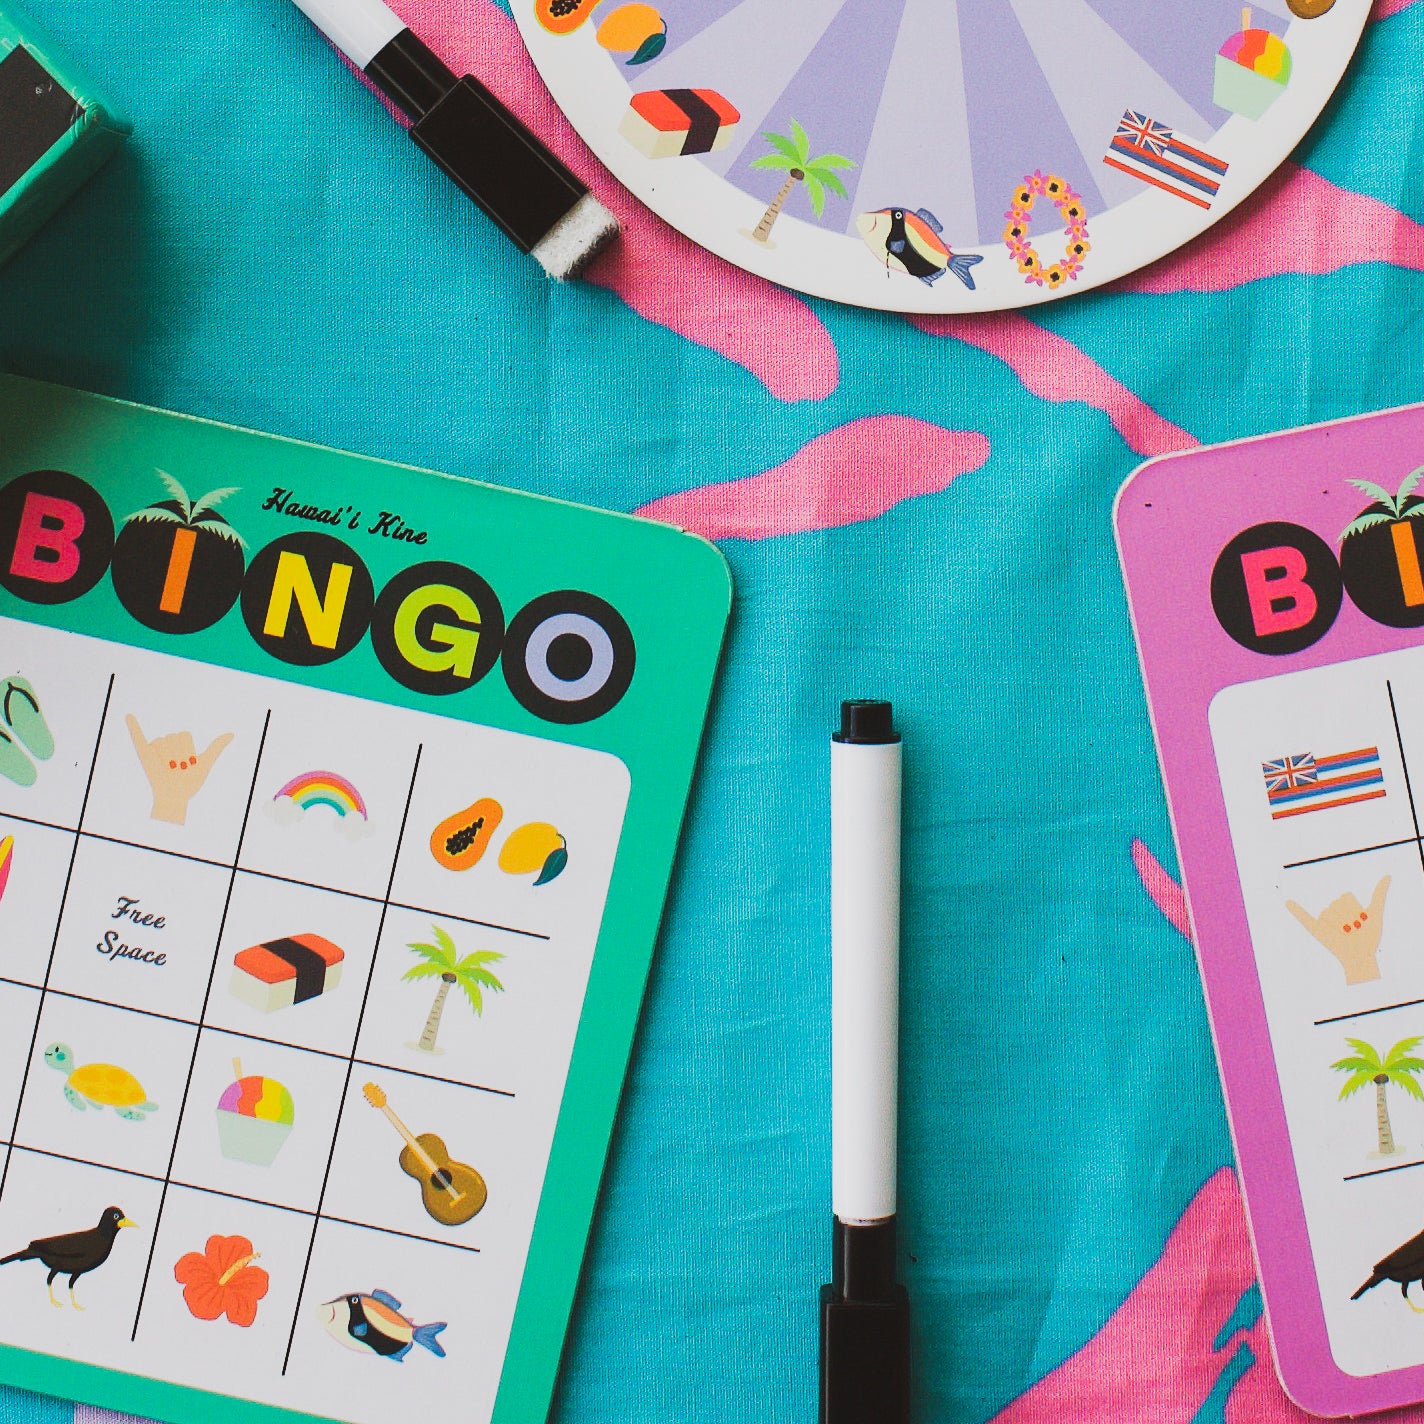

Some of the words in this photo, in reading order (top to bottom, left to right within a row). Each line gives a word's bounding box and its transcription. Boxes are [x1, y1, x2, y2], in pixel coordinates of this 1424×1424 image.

[367, 511, 428, 545] Kine
[9, 493, 614, 702] BINGO
[111, 896, 166, 929] Free
[96, 930, 167, 966] Space
